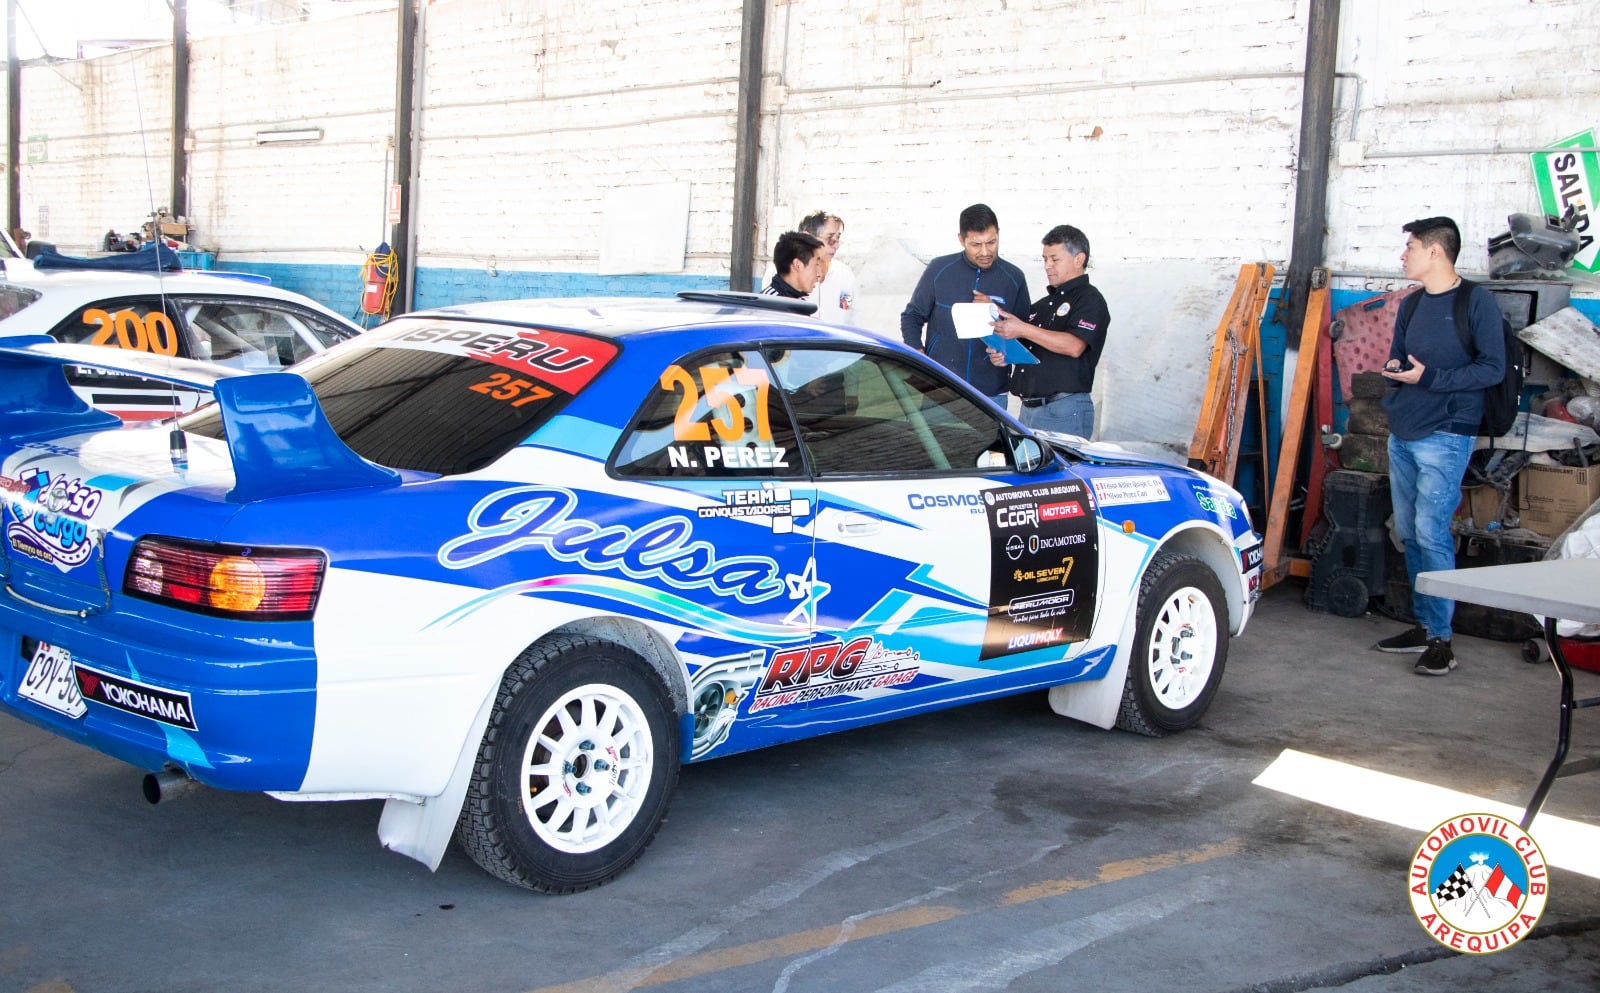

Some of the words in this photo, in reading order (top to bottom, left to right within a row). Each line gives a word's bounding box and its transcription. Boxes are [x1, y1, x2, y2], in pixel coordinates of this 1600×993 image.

[82, 308, 178, 357] 200
[468, 372, 554, 407] 257
[660, 364, 772, 442] 257
[667, 446, 698, 468] N.
[704, 446, 789, 468] PEREZ
[722, 489, 774, 505] TEAM
[995, 490, 1032, 502] AUTOMOVIL
[1032, 487, 1050, 497] CLUB
[1050, 484, 1080, 495] AREQUIPA
[698, 504, 791, 518] CONQUISTADORES
[1008, 503, 1033, 511] REPUESTOS
[1042, 503, 1078, 517] MOTOR'S
[437, 485, 786, 605] Julsa
[1005, 543, 1025, 551] NISSAN
[1040, 533, 1086, 549] INCAMOTORS
[1036, 566, 1065, 578] SEVEN
[758, 637, 873, 694] RPG
[100, 679, 191, 723] YOKOHAMA
[750, 690, 797, 713] RACING
[794, 678, 876, 702] PERFORMANCE
[872, 669, 920, 688] GARAGE
